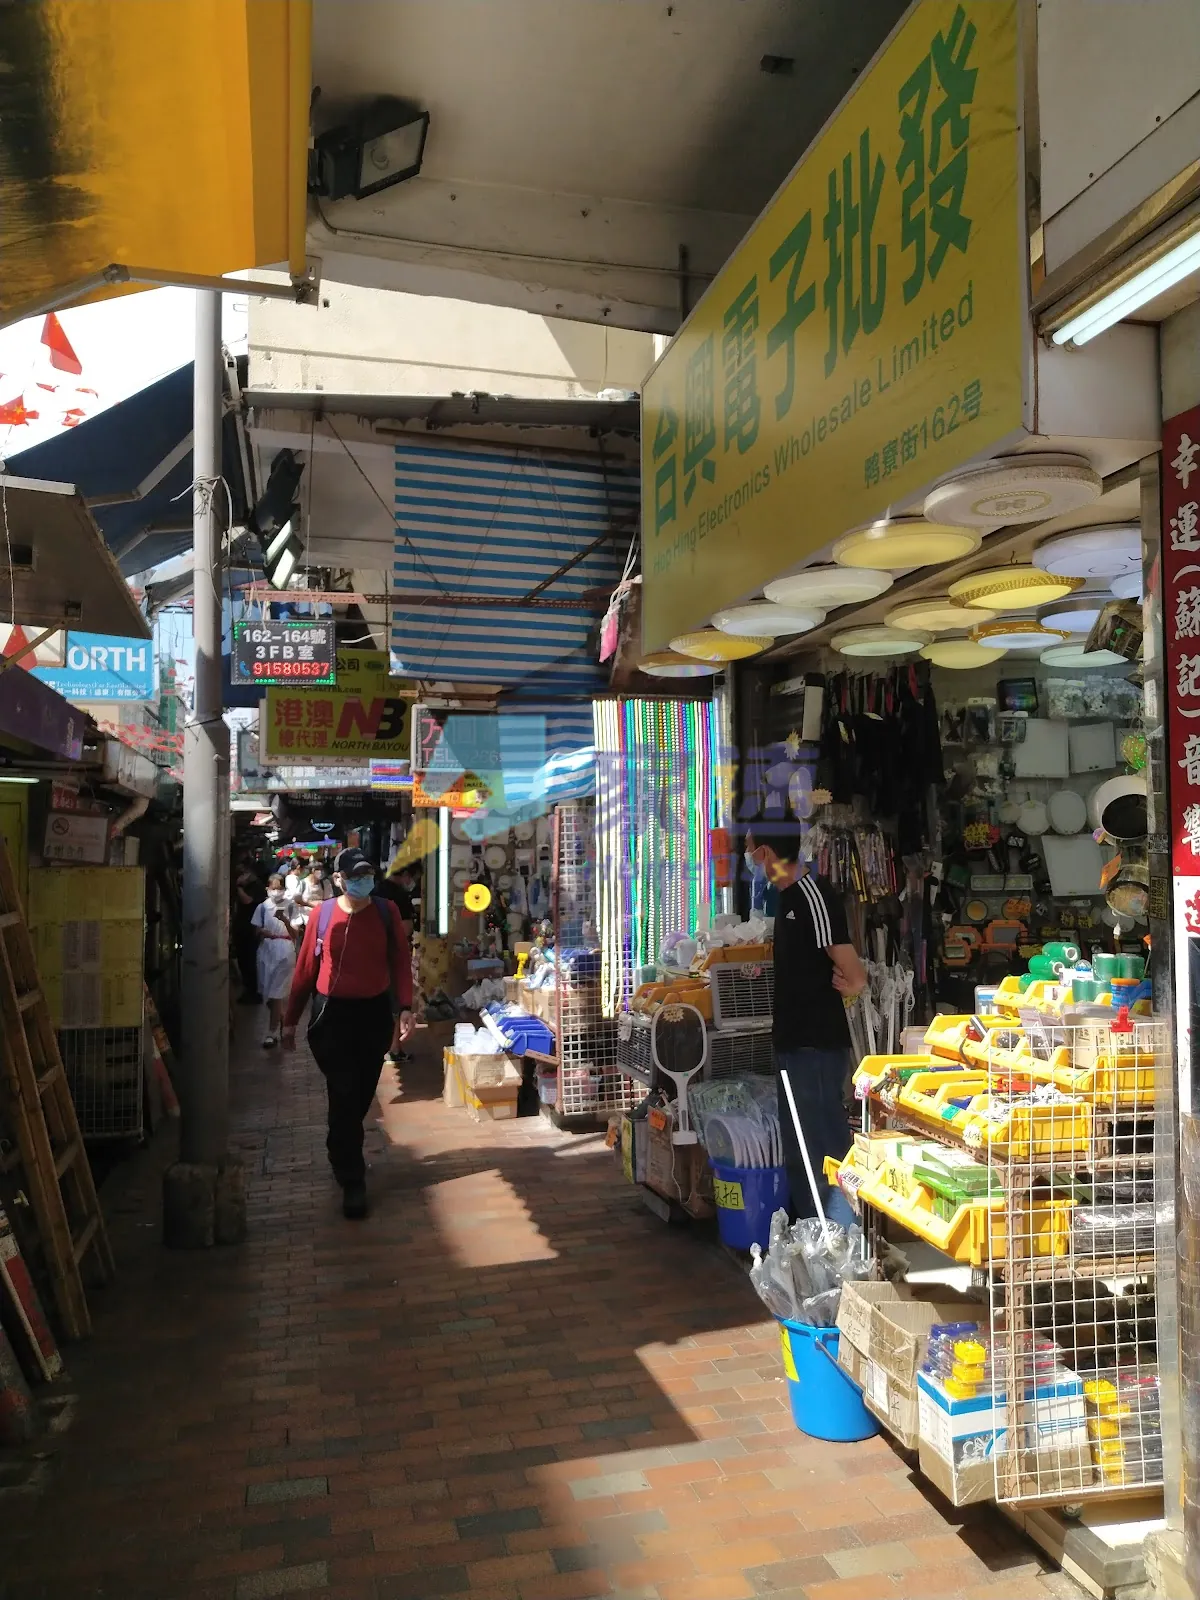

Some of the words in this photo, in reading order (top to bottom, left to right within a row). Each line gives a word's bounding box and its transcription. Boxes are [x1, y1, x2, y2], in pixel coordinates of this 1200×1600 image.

[652, 4, 979, 537] 合興電子批發
[700, 464, 770, 540] Electronics
[774, 377, 872, 477] Wholesale
[878, 279, 974, 393] Limited
[242, 629, 327, 644] 162-164號
[253, 662, 330, 677] 91580537
[274, 697, 334, 728] 港澳
[336, 696, 408, 740] NB
[278, 729, 329, 749] 總代理
[331, 740, 371, 750] NORTH
[372, 741, 410, 751] BAYOU
